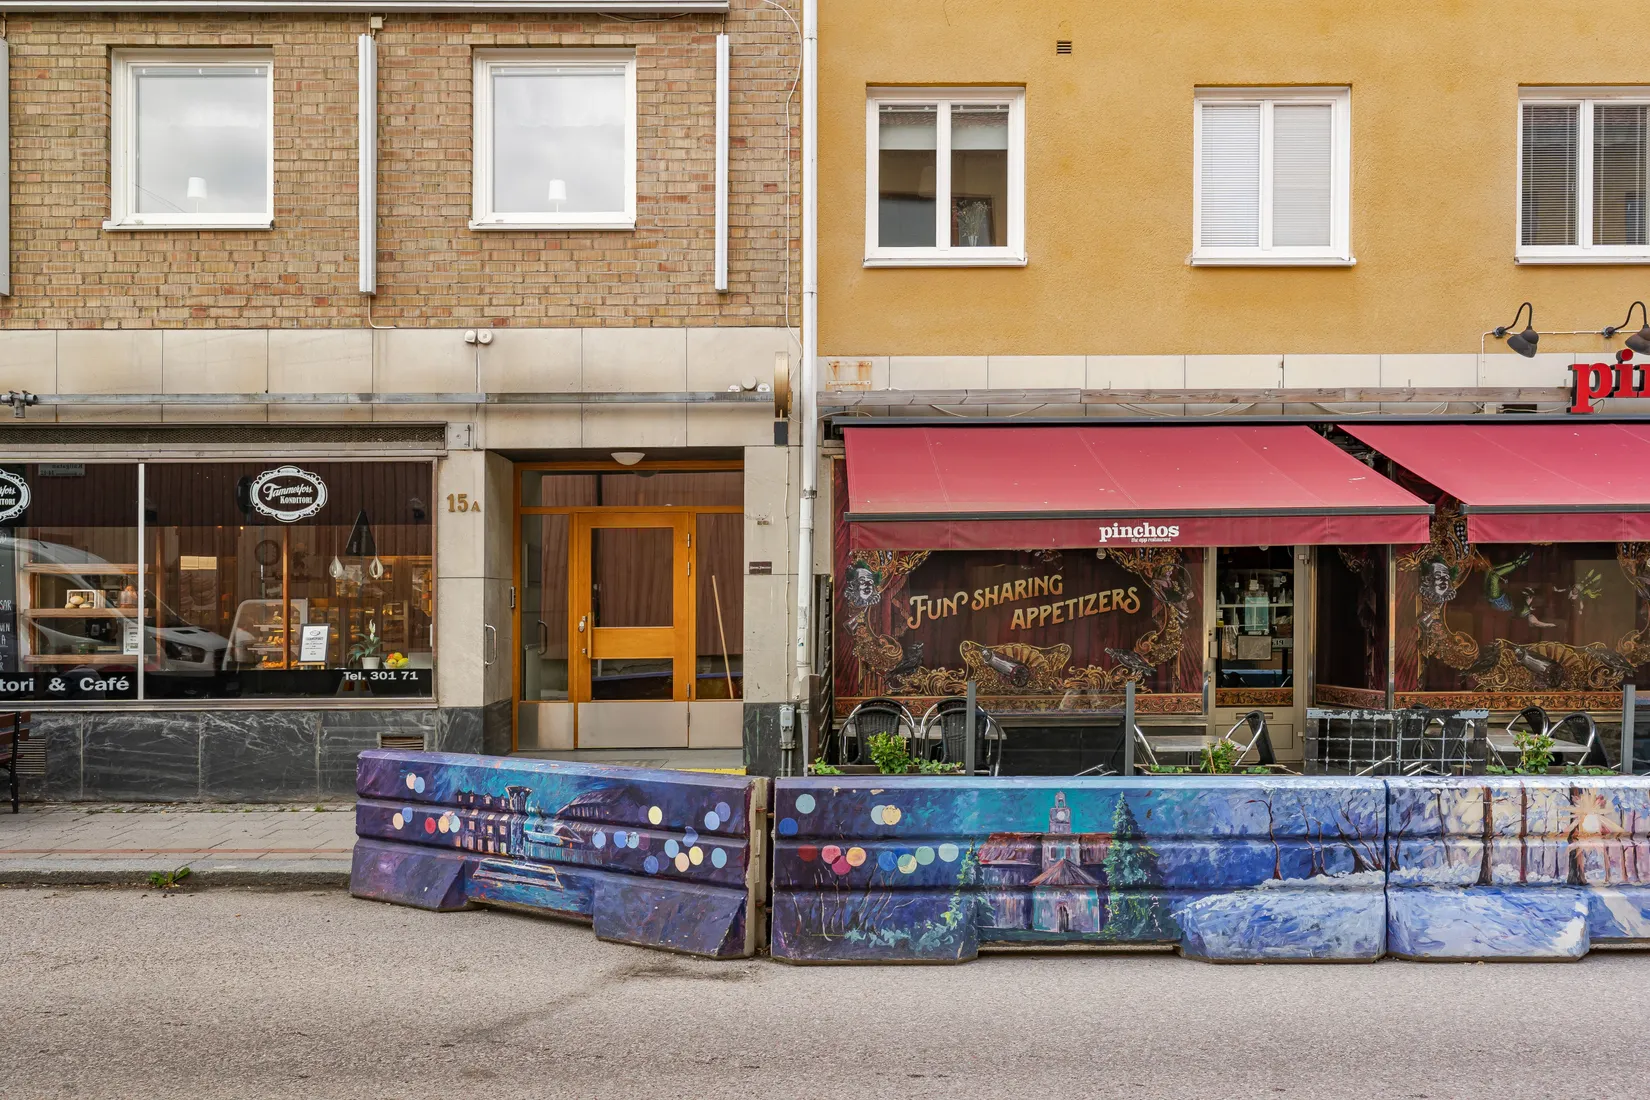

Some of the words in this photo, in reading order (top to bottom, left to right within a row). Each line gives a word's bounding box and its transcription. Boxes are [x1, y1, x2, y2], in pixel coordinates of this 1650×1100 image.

[262, 483, 313, 501] Tammerfors
[280, 496, 313, 504] KONDITORI
[1098, 522, 1180, 543] pinchos
[971, 574, 1063, 611] SHARING
[1010, 586, 1141, 631] APPETIZERS
[48, 677, 66, 692] &
[79, 676, 130, 691] Café
[343, 671, 366, 680] Tel.
[370, 671, 397, 680] 301
[401, 671, 419, 680] 71
